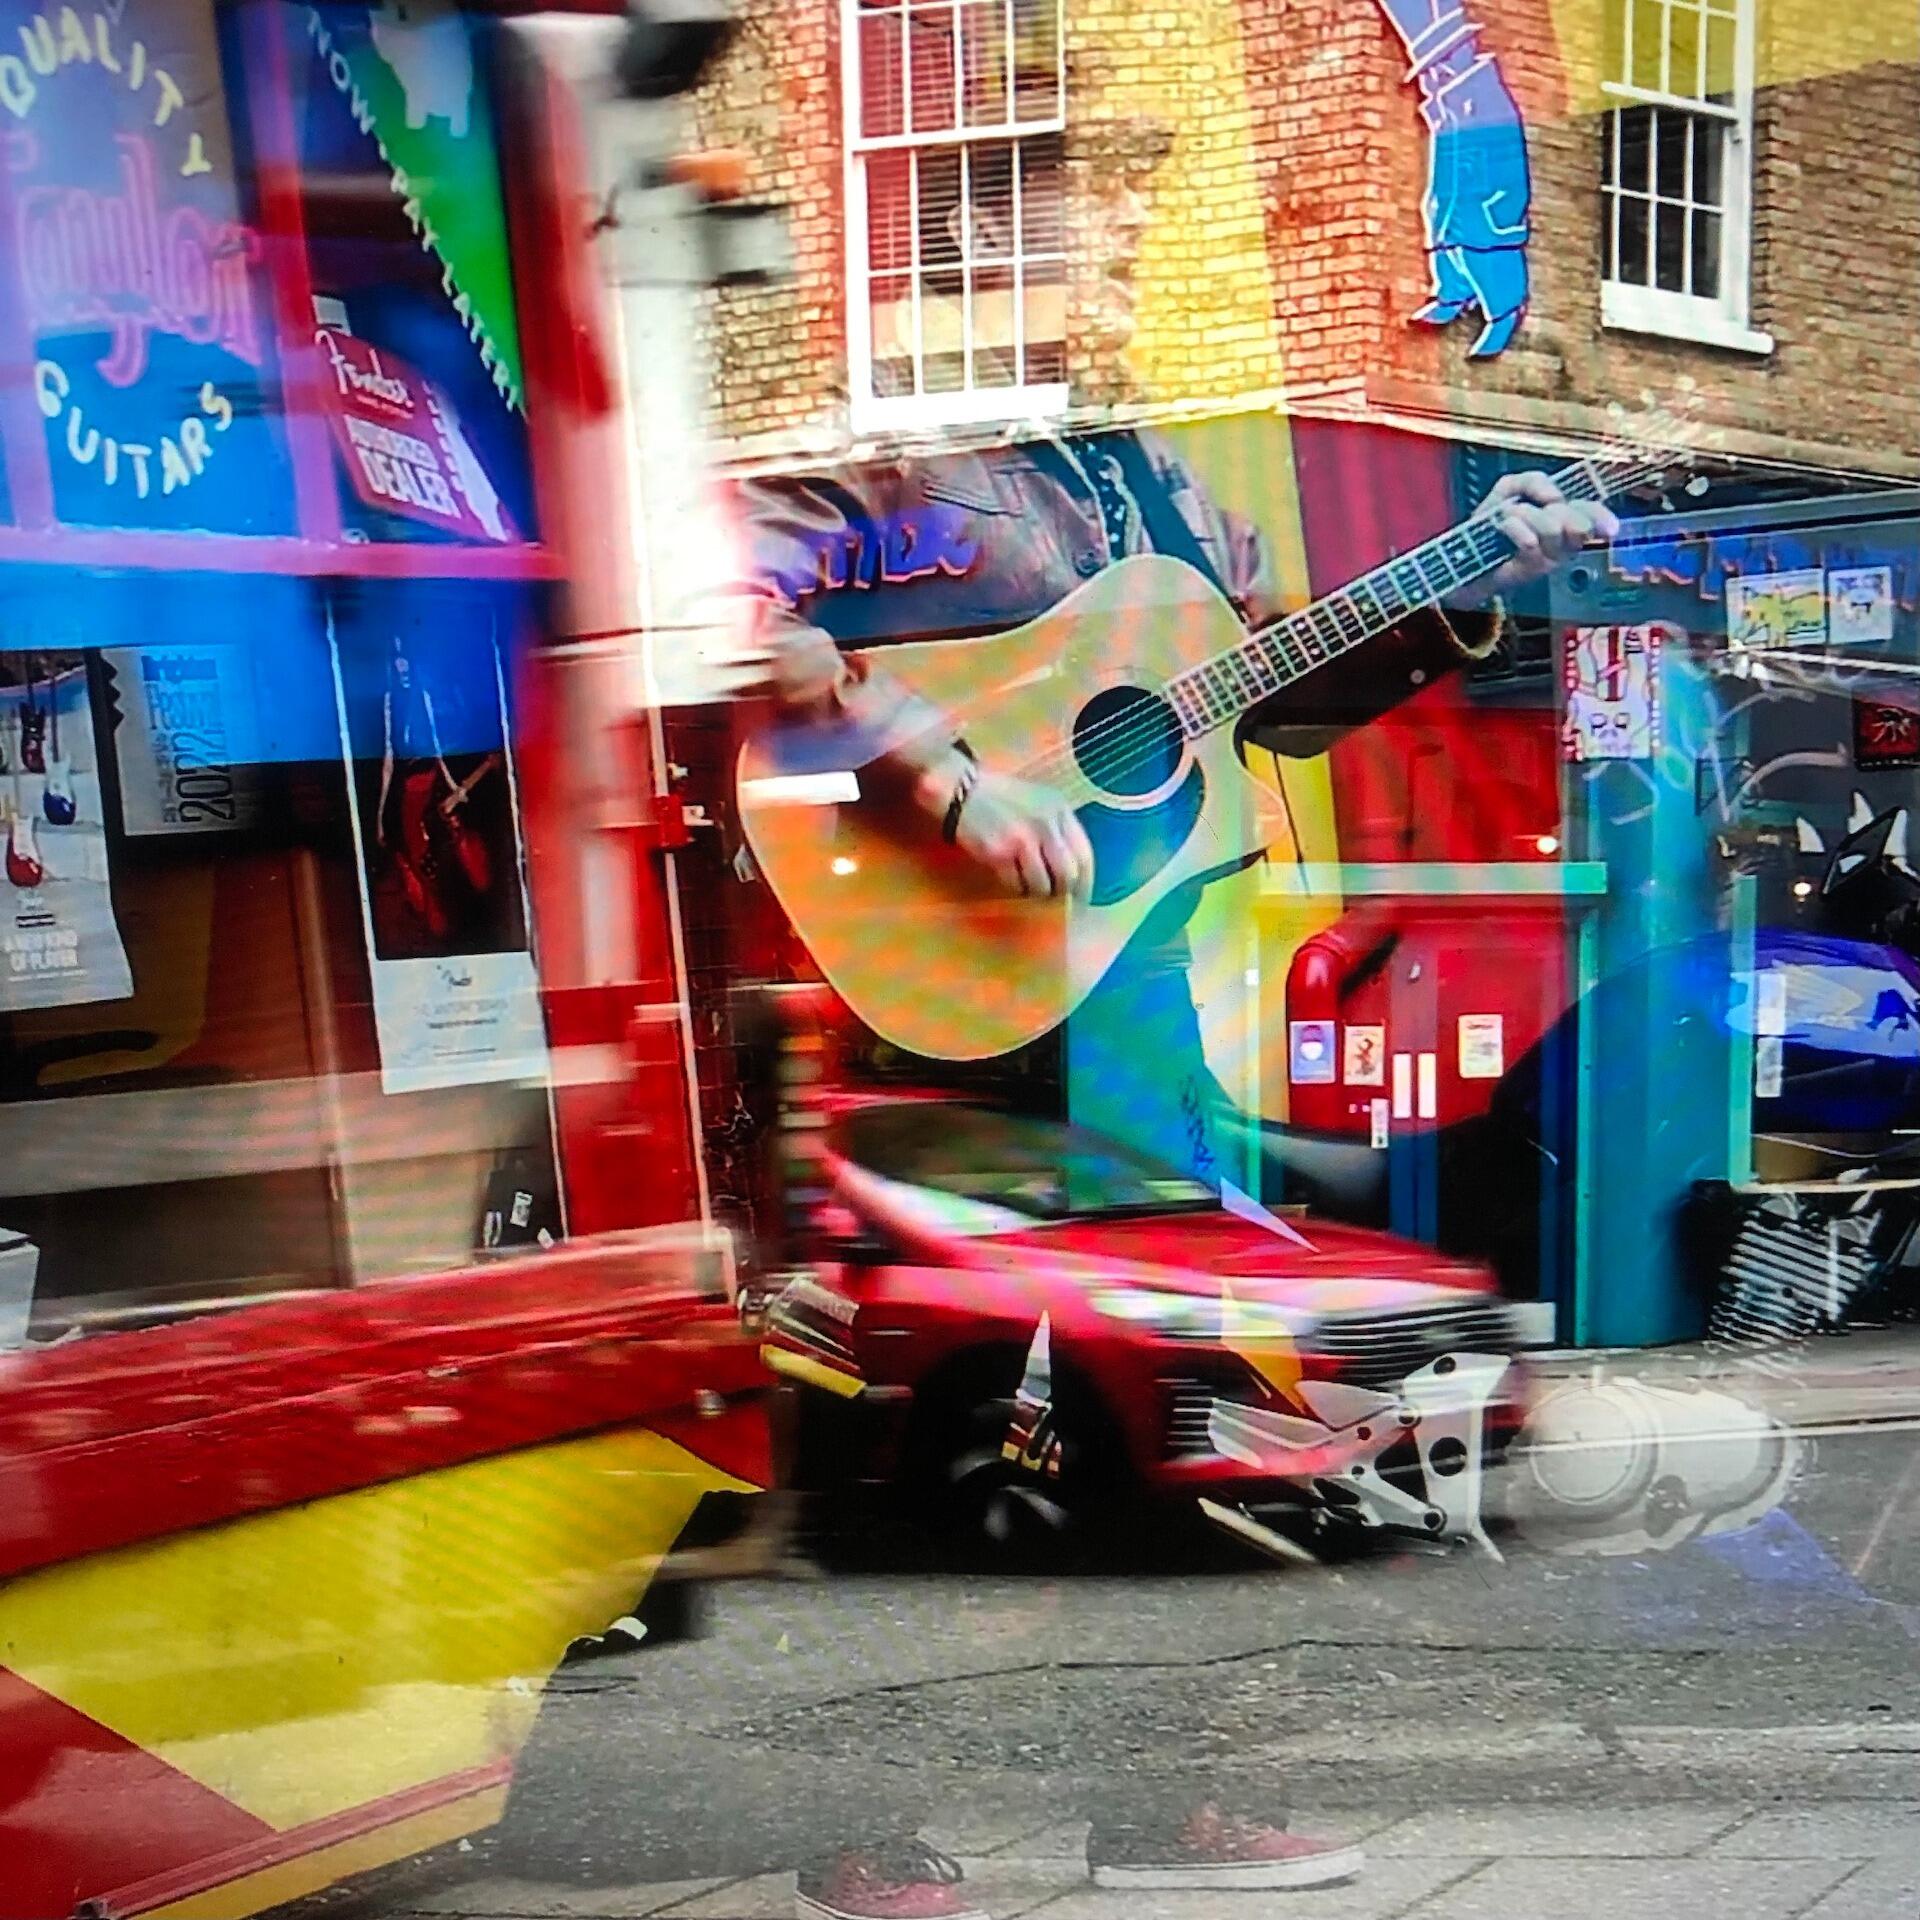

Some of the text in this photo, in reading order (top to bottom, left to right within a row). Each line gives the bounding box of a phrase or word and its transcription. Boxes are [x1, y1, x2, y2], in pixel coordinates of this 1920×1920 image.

[0, 6, 213, 176] QUALITY
[307, 8, 377, 136] NOW
[390, 164, 441, 253] PAY
[35, 360, 234, 499] GUITARS
[354, 446, 462, 520] DEALER
[171, 728, 237, 823] 2022
